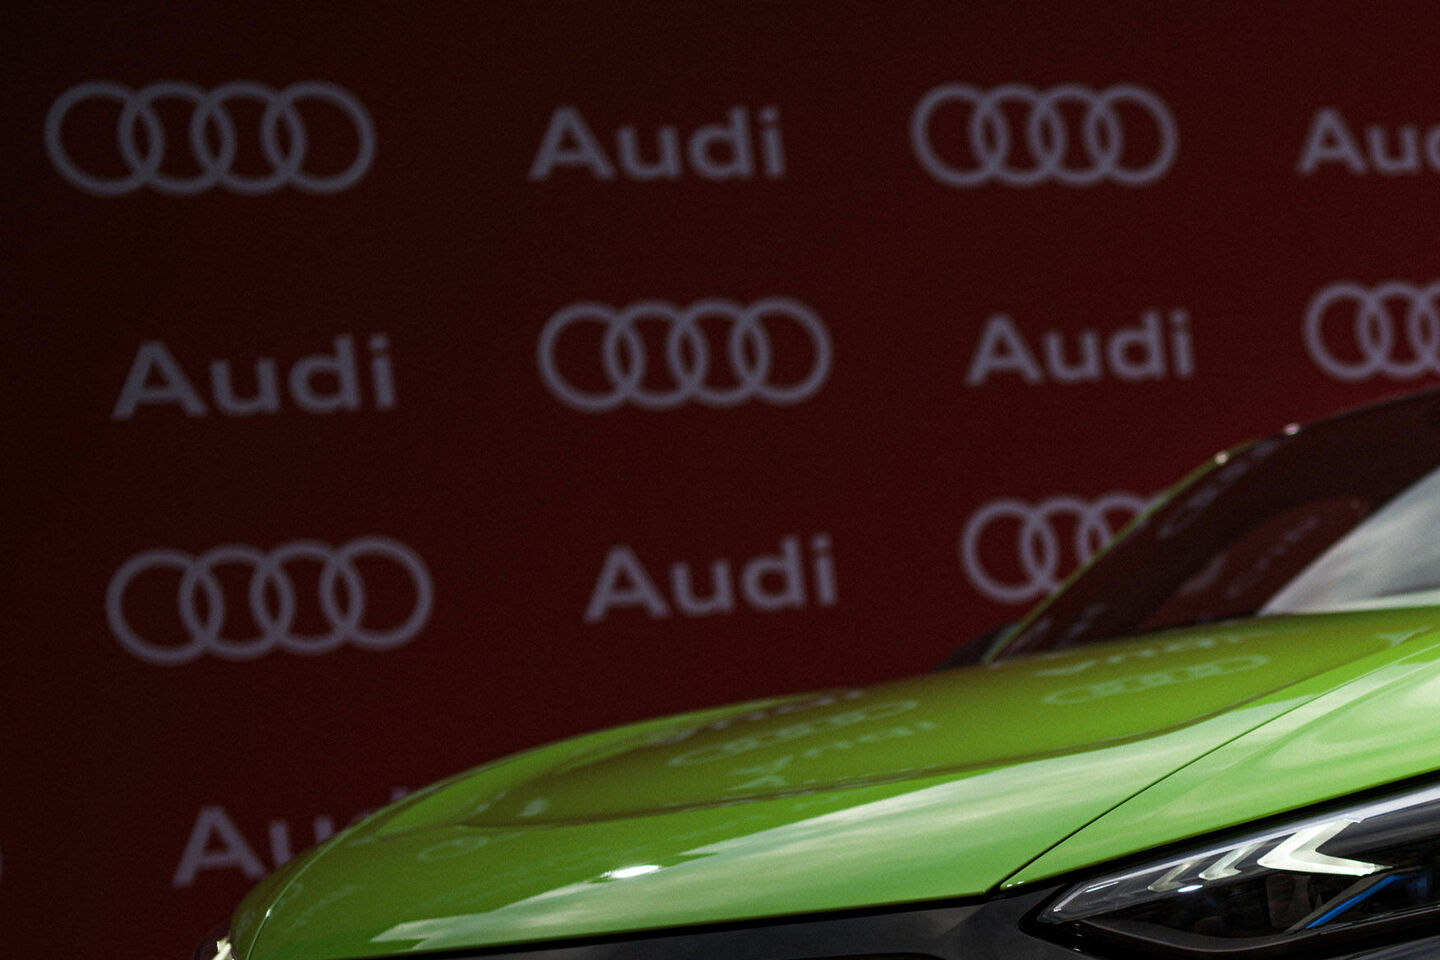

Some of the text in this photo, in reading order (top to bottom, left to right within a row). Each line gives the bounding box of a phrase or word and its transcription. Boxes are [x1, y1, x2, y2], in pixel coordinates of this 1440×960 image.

[530, 107, 785, 180] Audi
[113, 333, 396, 419] Audi
[967, 310, 1194, 385] Audi
[586, 534, 837, 622] Audi
